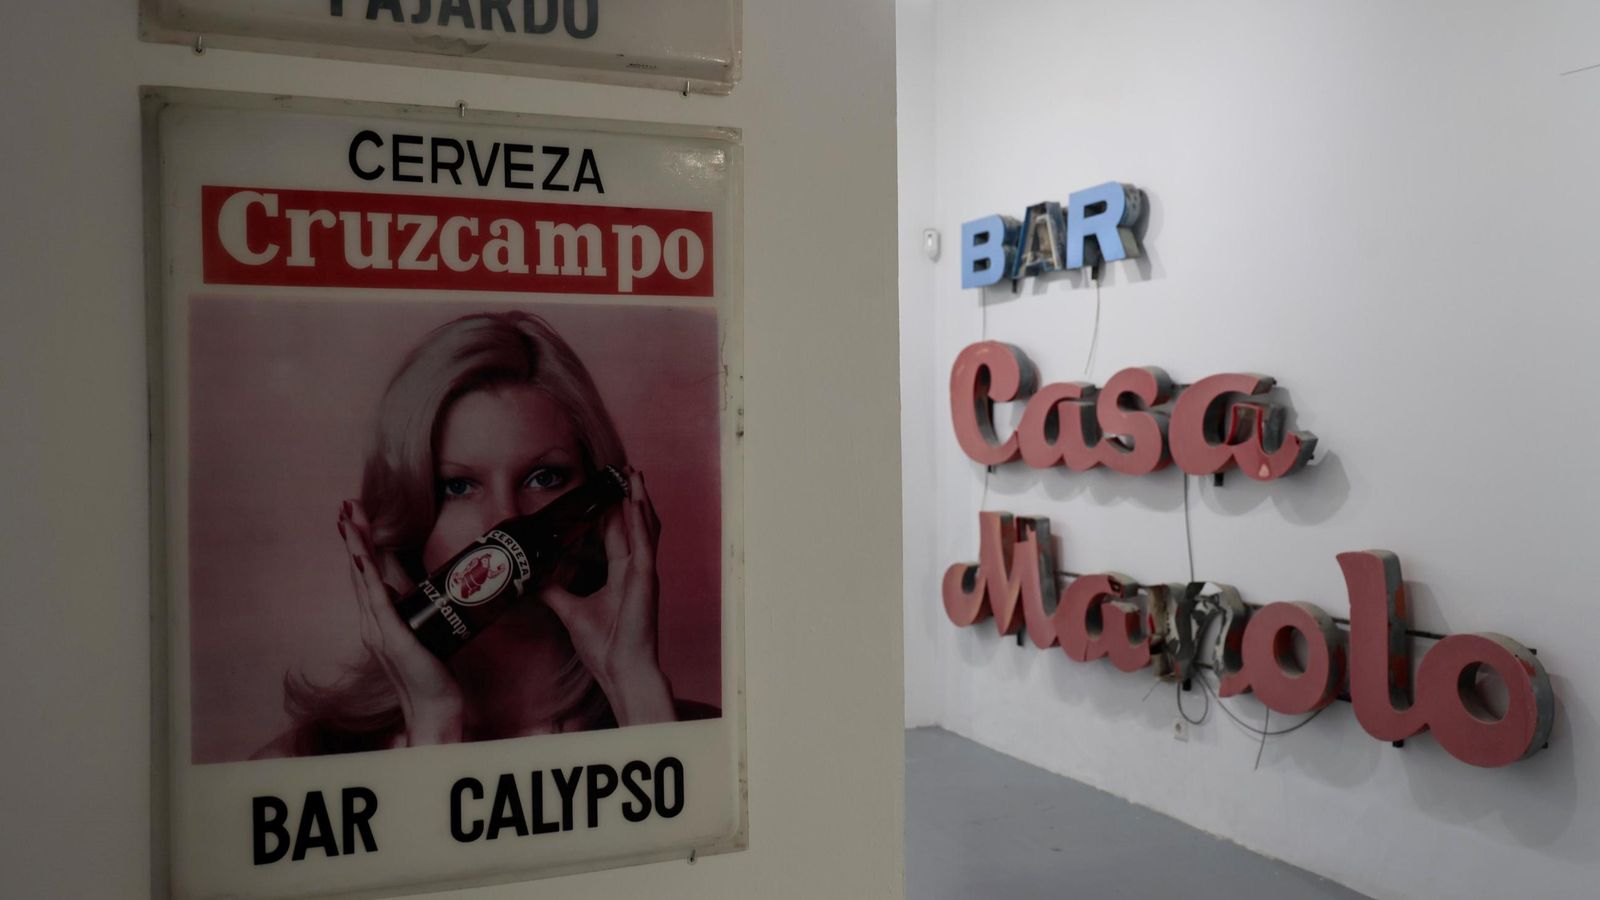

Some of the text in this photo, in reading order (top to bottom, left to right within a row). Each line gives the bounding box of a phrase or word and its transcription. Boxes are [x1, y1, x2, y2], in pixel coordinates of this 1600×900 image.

[348, 129, 606, 194] CERVEZA
[217, 190, 706, 293] Cruzcampo
[961, 182, 1148, 290] BAR
[949, 340, 1318, 482] Casa
[491, 530, 529, 576] CERVEZA
[252, 756, 686, 866] BAR CALYPSO
